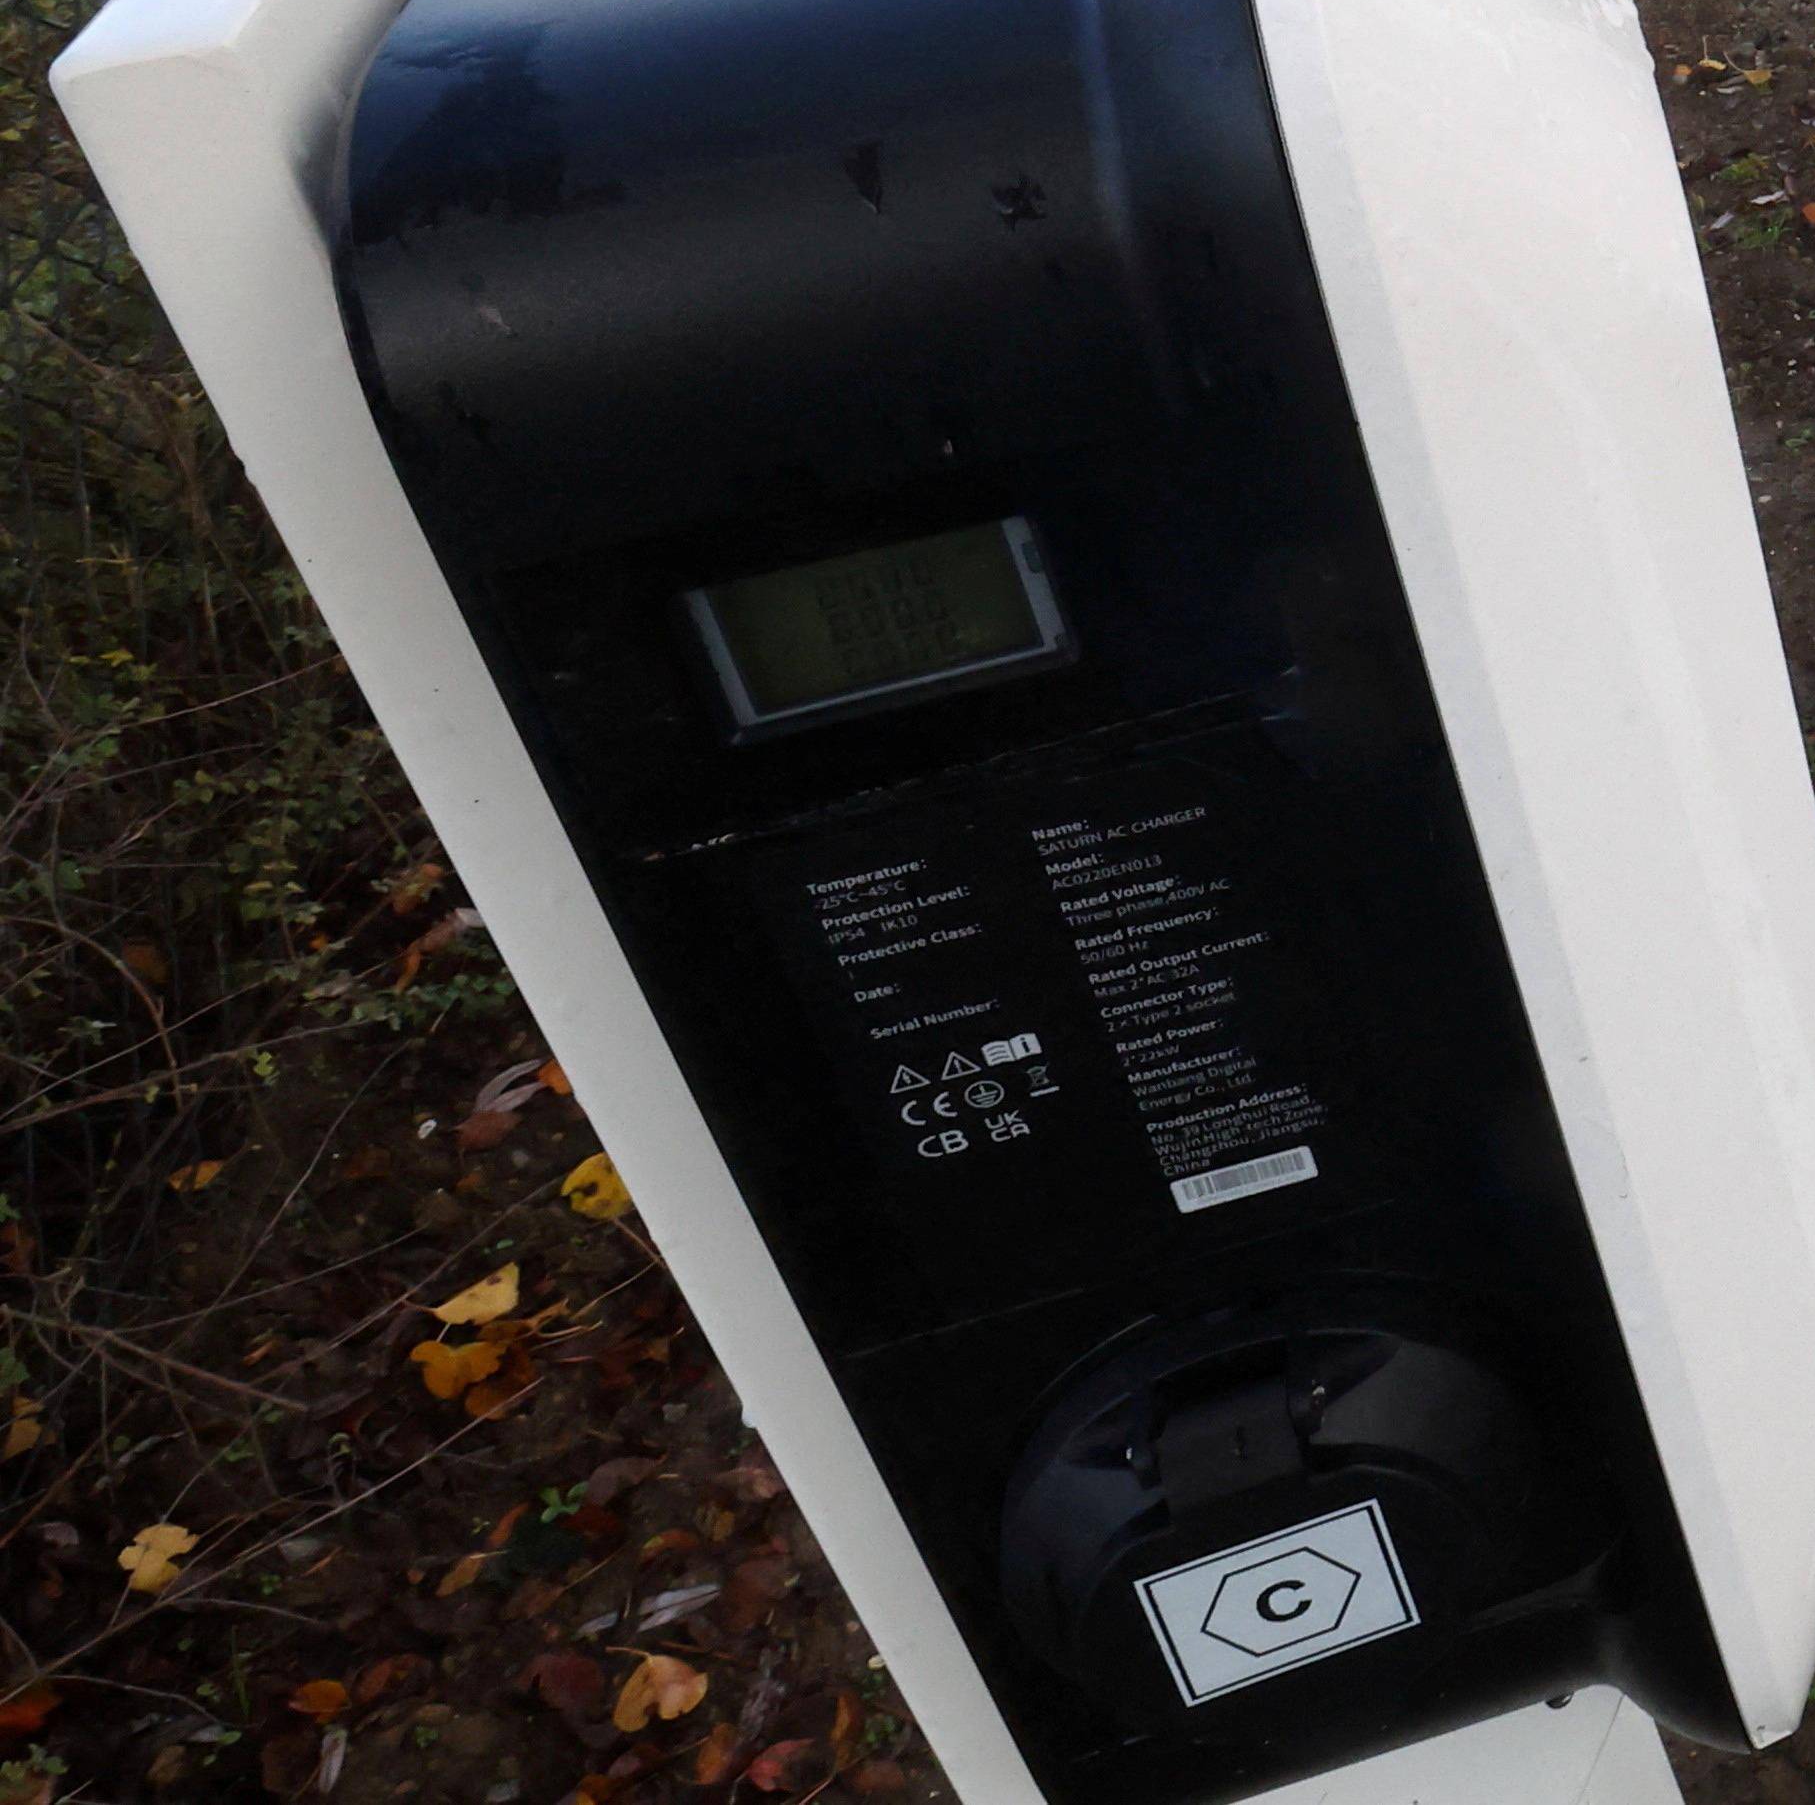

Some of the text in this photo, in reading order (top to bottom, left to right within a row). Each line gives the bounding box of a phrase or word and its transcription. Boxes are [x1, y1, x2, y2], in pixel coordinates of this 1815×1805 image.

[1031, 818, 1090, 841] Name:
[1038, 806, 1207, 857] SATURN AC CHARGER
[806, 859, 927, 895] Temperature:
[1045, 852, 1105, 875] Model:
[821, 885, 971, 931] Protection Level:
[1060, 874, 1182, 913] Rated Voltage:
[1066, 909, 1113, 927] Three
[1209, 879, 1231, 891] AC
[838, 922, 984, 967] Protective Class:
[1074, 906, 1220, 951] Rated Frequency:
[1080, 945, 1126, 965] 50/60
[1088, 931, 1271, 985] Rated Output Current:
[853, 983, 901, 1003] Date:
[1094, 985, 1126, 998] Max
[1101, 977, 1234, 1019] Connector Type:
[870, 999, 1000, 1040] Serial Number:
[1116, 1019, 1224, 1053] Rated Power:
[1128, 1047, 1241, 1083] Manufacturer:
[1146, 1083, 1308, 1133] Production Address:
[1255, 1579, 1313, 1623] C
